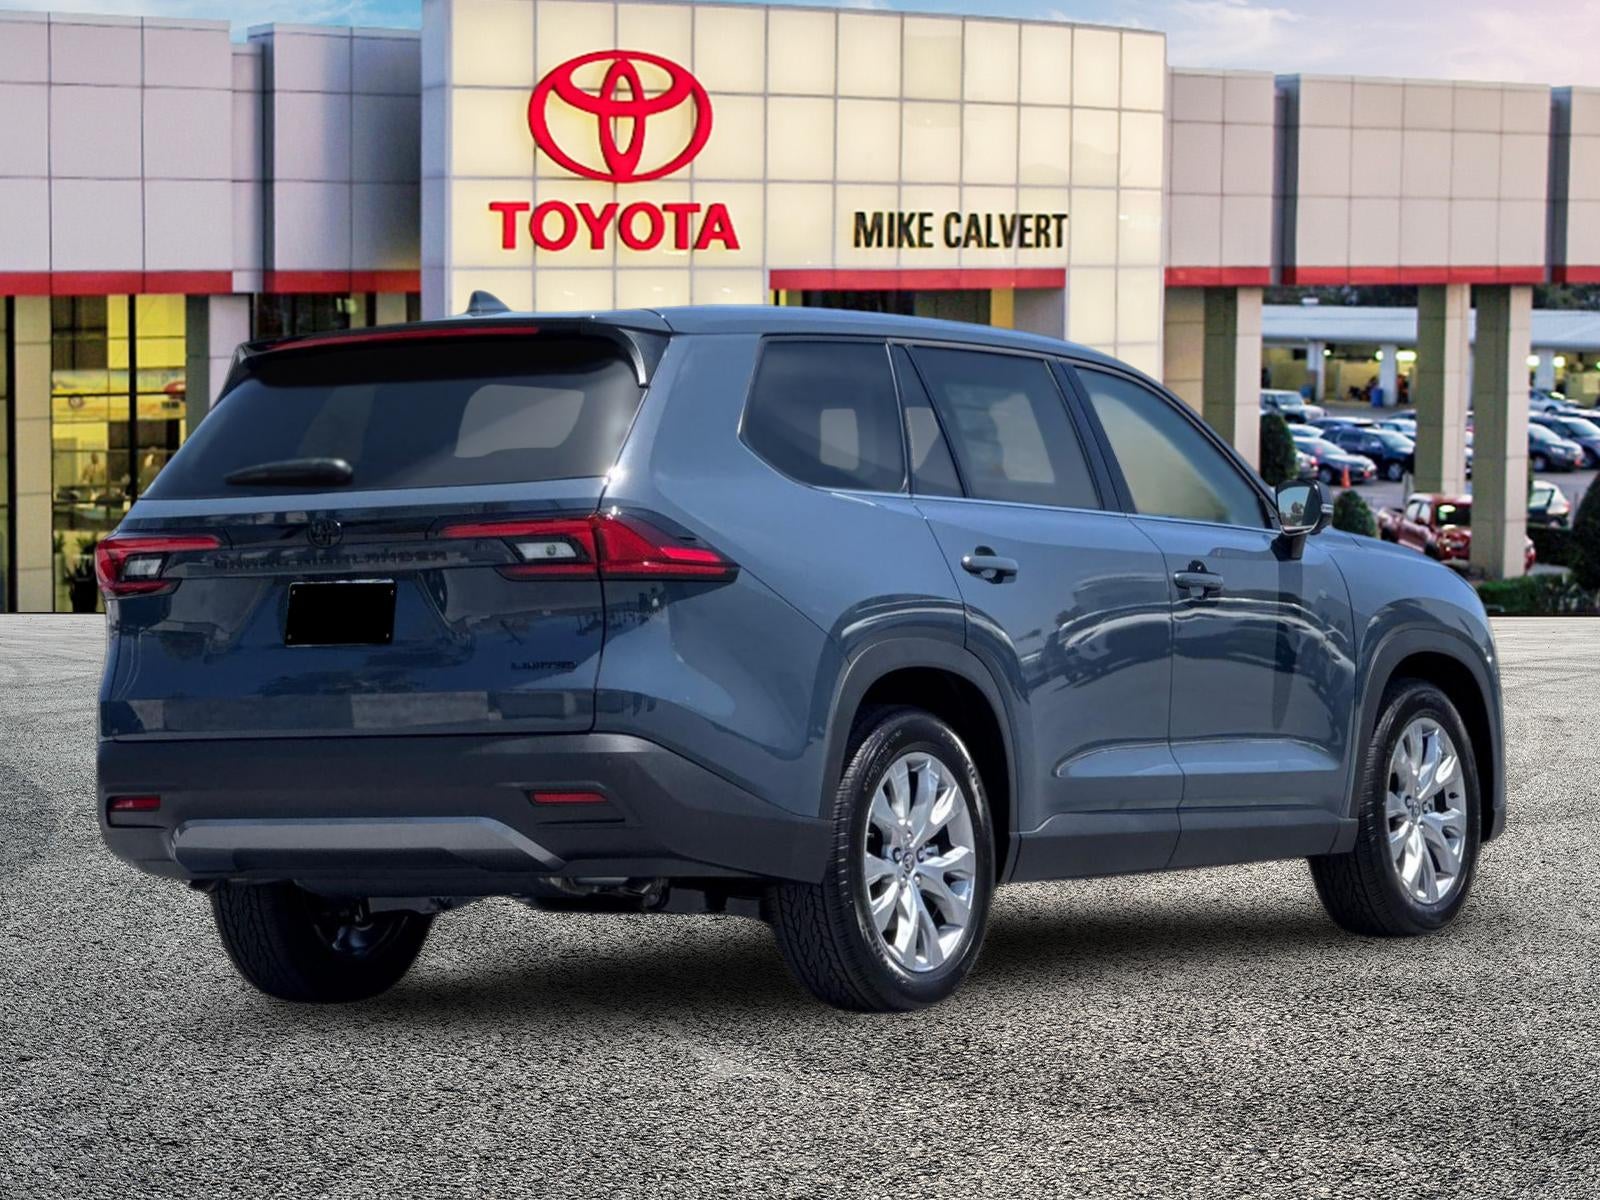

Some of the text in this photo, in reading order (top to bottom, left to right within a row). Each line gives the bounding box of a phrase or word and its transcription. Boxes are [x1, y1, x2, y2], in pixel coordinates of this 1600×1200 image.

[489, 200, 741, 250] TOYOTA
[853, 212, 1068, 248] MIKE CALVERT
